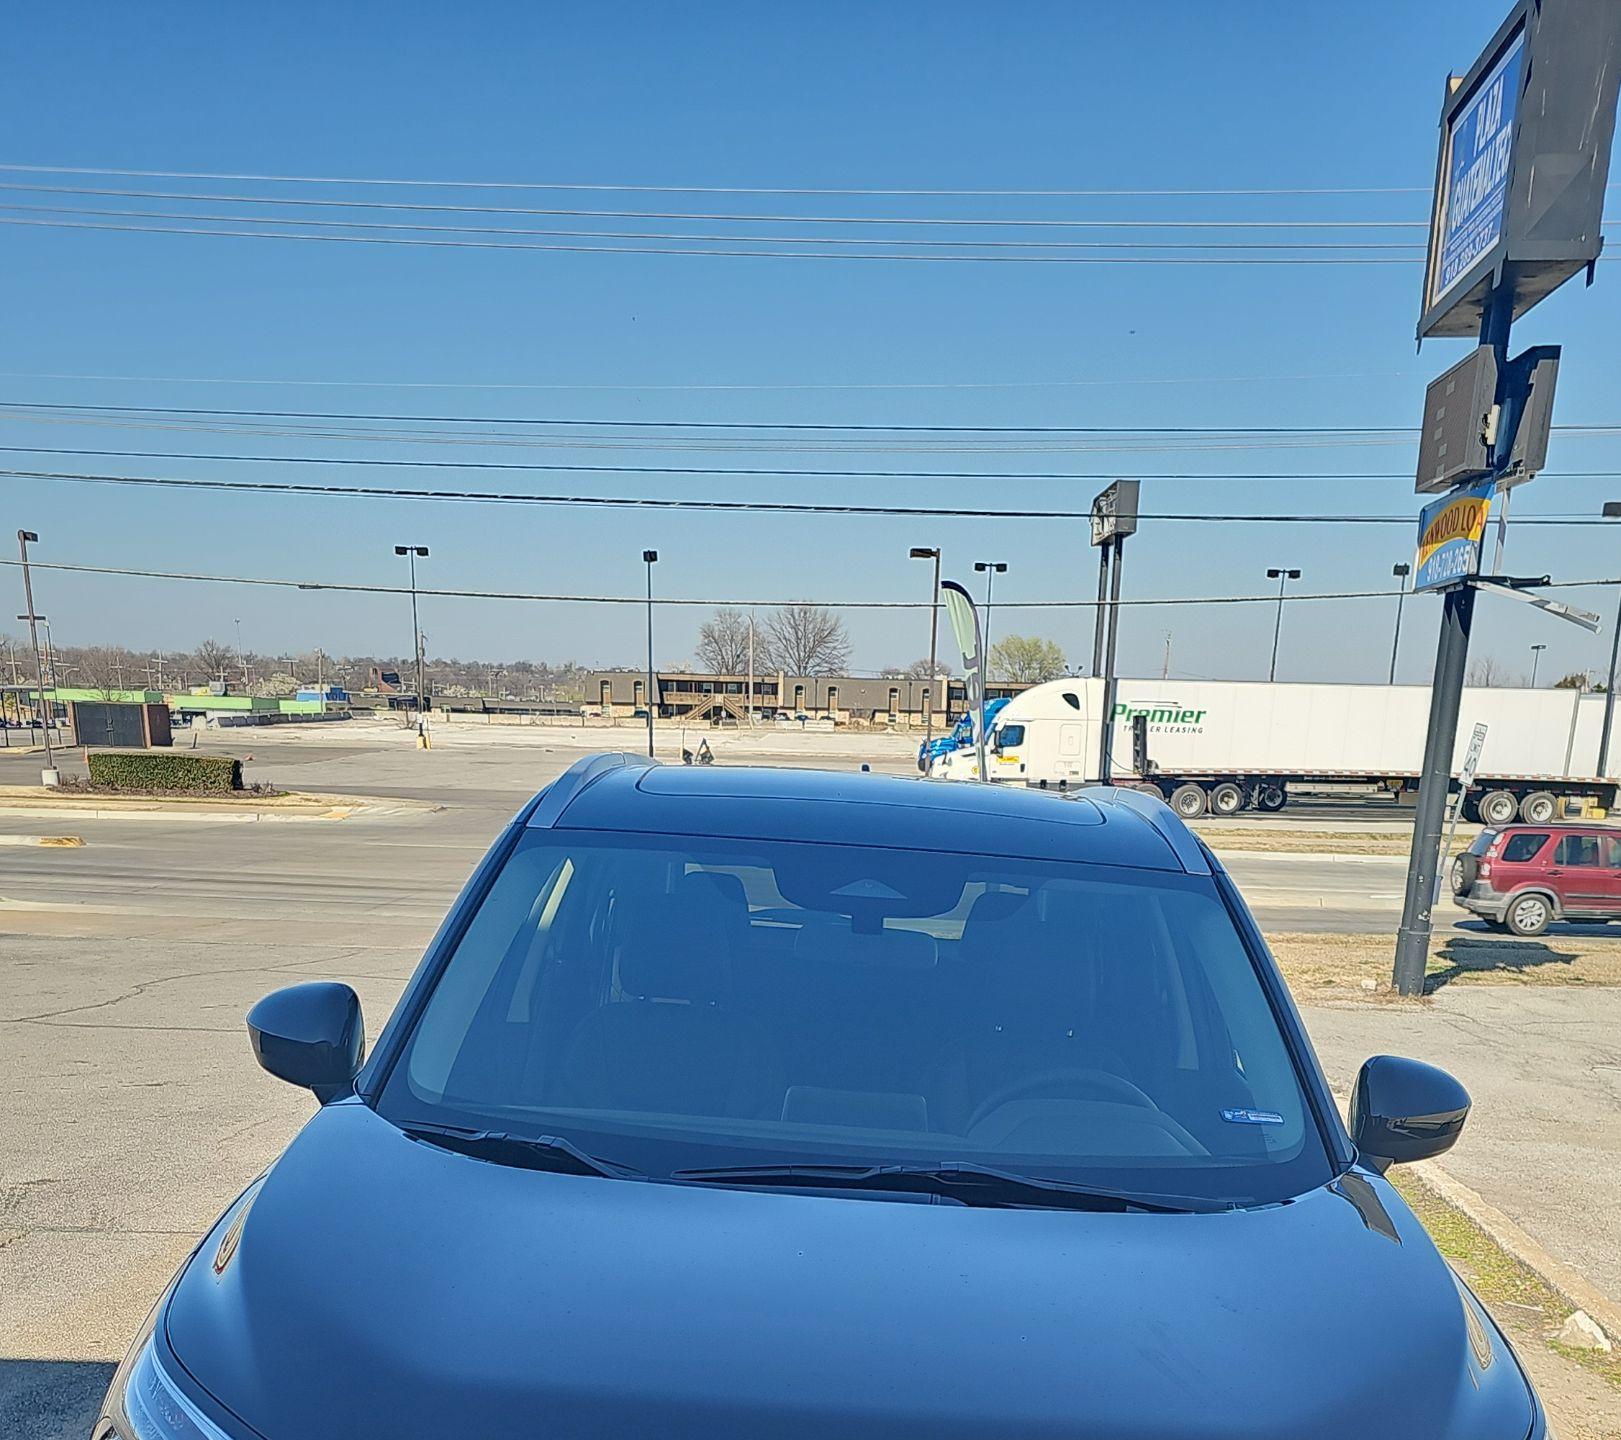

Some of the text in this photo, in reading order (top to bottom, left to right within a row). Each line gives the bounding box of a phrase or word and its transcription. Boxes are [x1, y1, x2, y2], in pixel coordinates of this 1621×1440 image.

[1473, 73, 1504, 158] PLAZA
[1110, 703, 1207, 723] Premier
[1123, 725, 1204, 733] TRER LEASING
